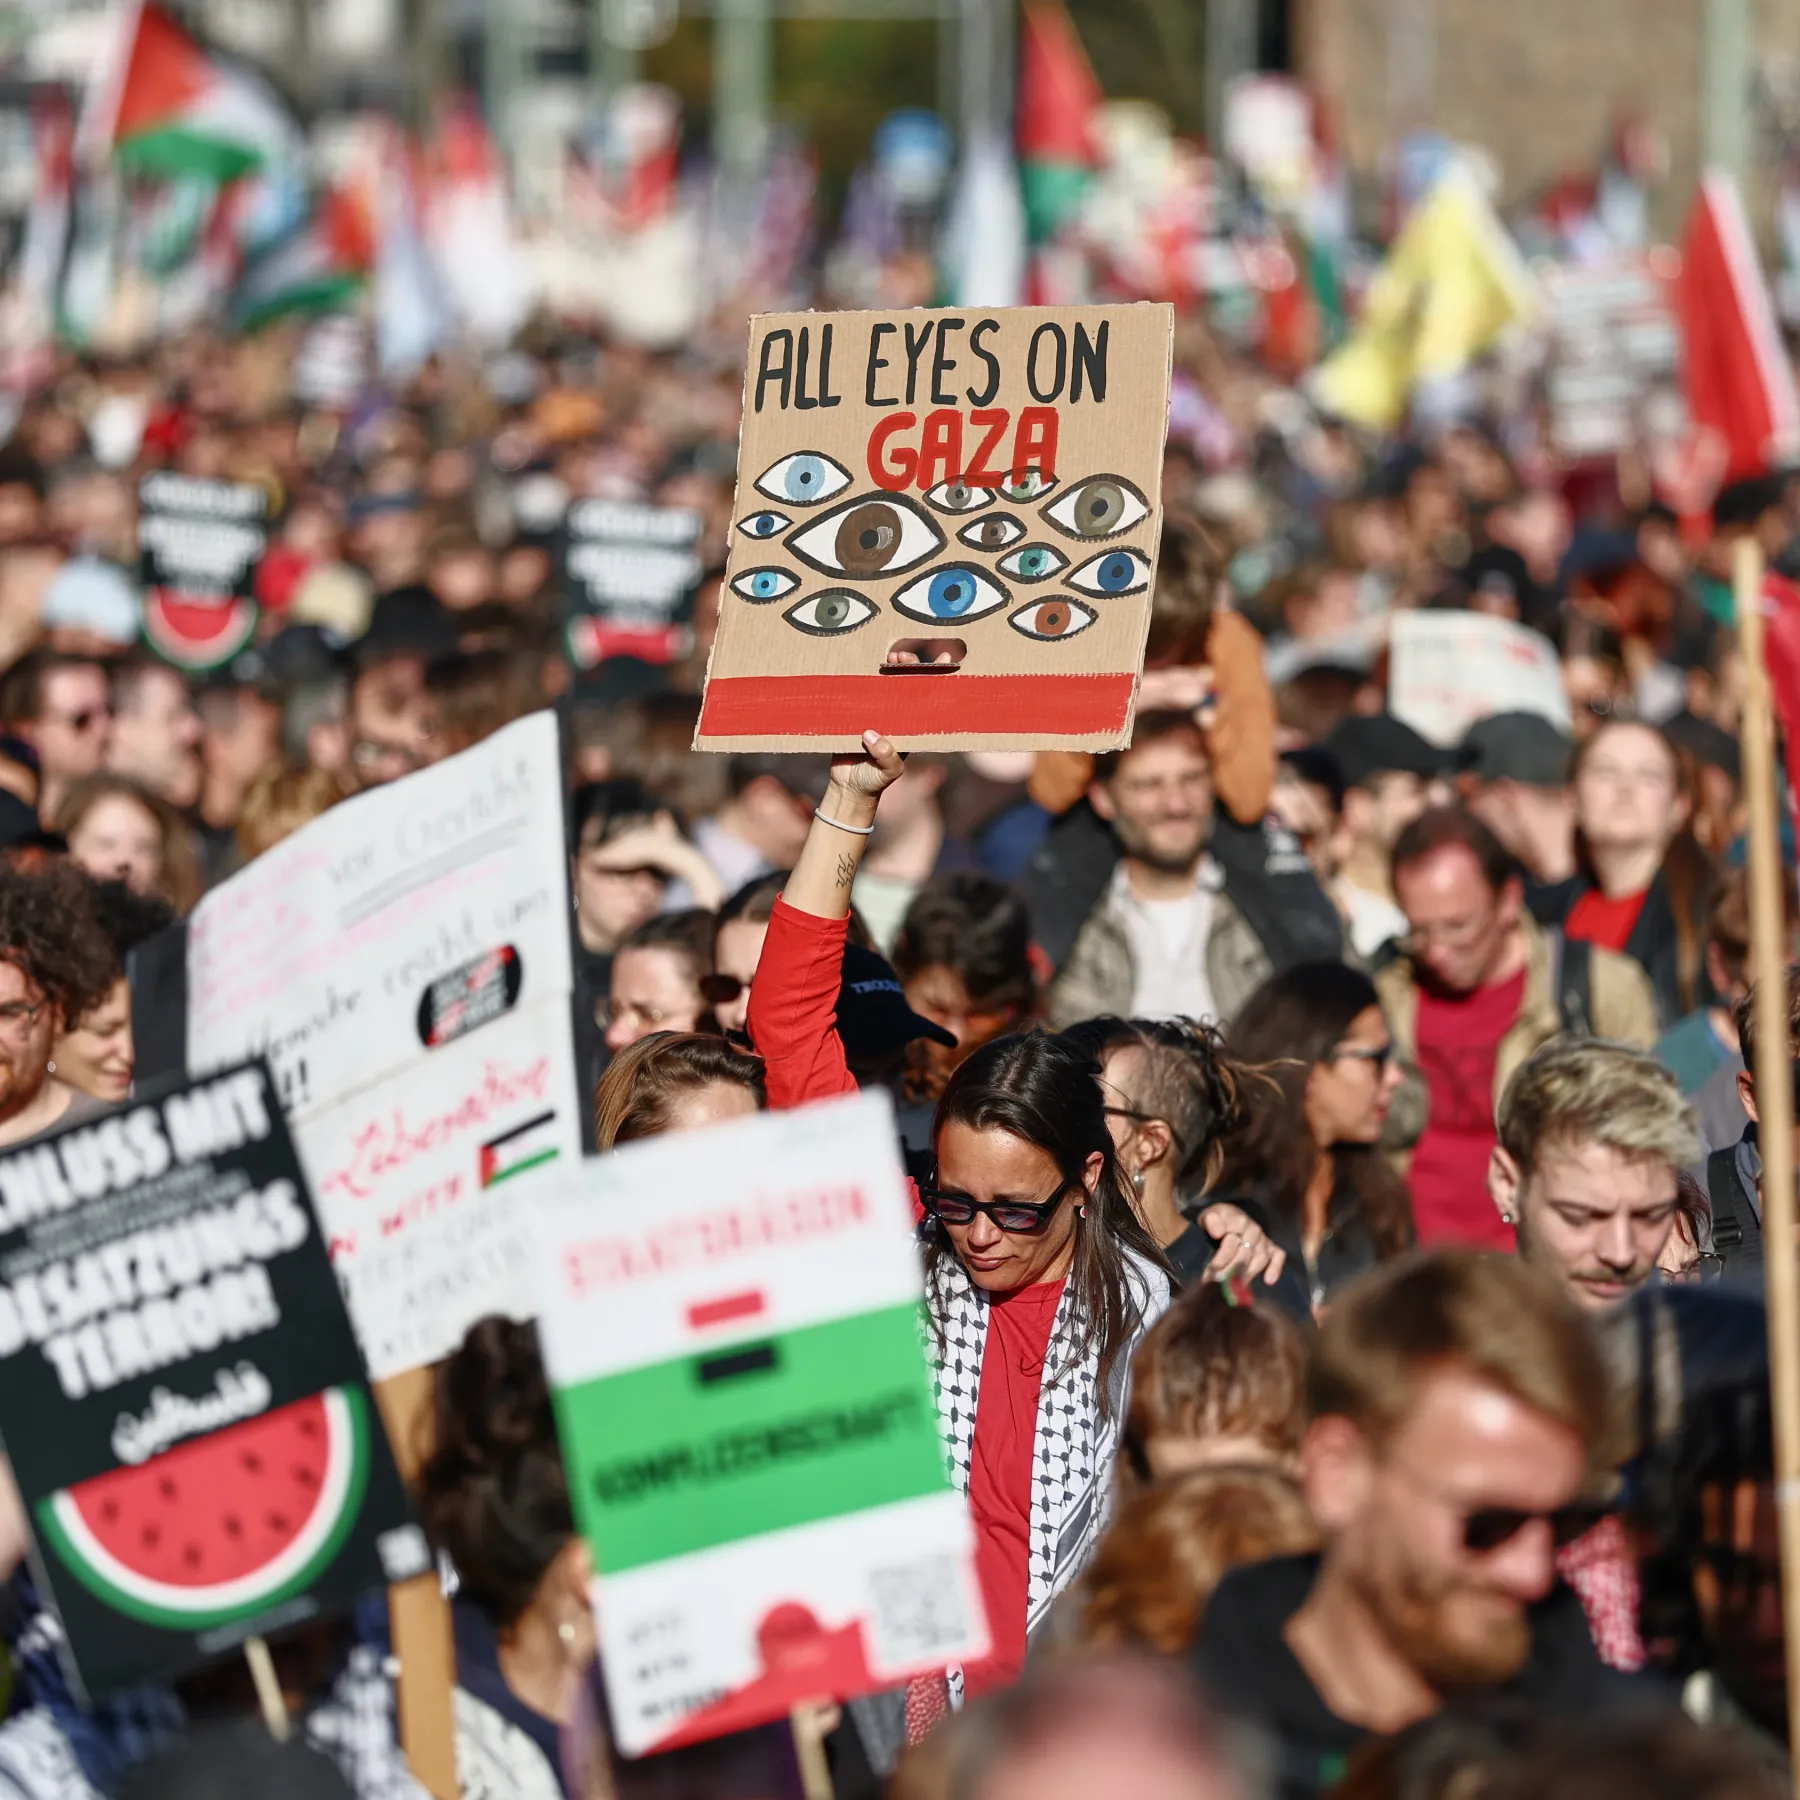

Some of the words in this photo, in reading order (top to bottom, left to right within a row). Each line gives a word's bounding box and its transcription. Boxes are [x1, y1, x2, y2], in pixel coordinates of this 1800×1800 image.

[754, 323, 842, 413] ALL
[865, 318, 1000, 407] EYES
[1026, 319, 1109, 405] ON
[866, 406, 1059, 491] GAZA
[163, 1066, 271, 1165] MIT
[590, 1392, 924, 1506] KOMPLIZENSCHAFT
